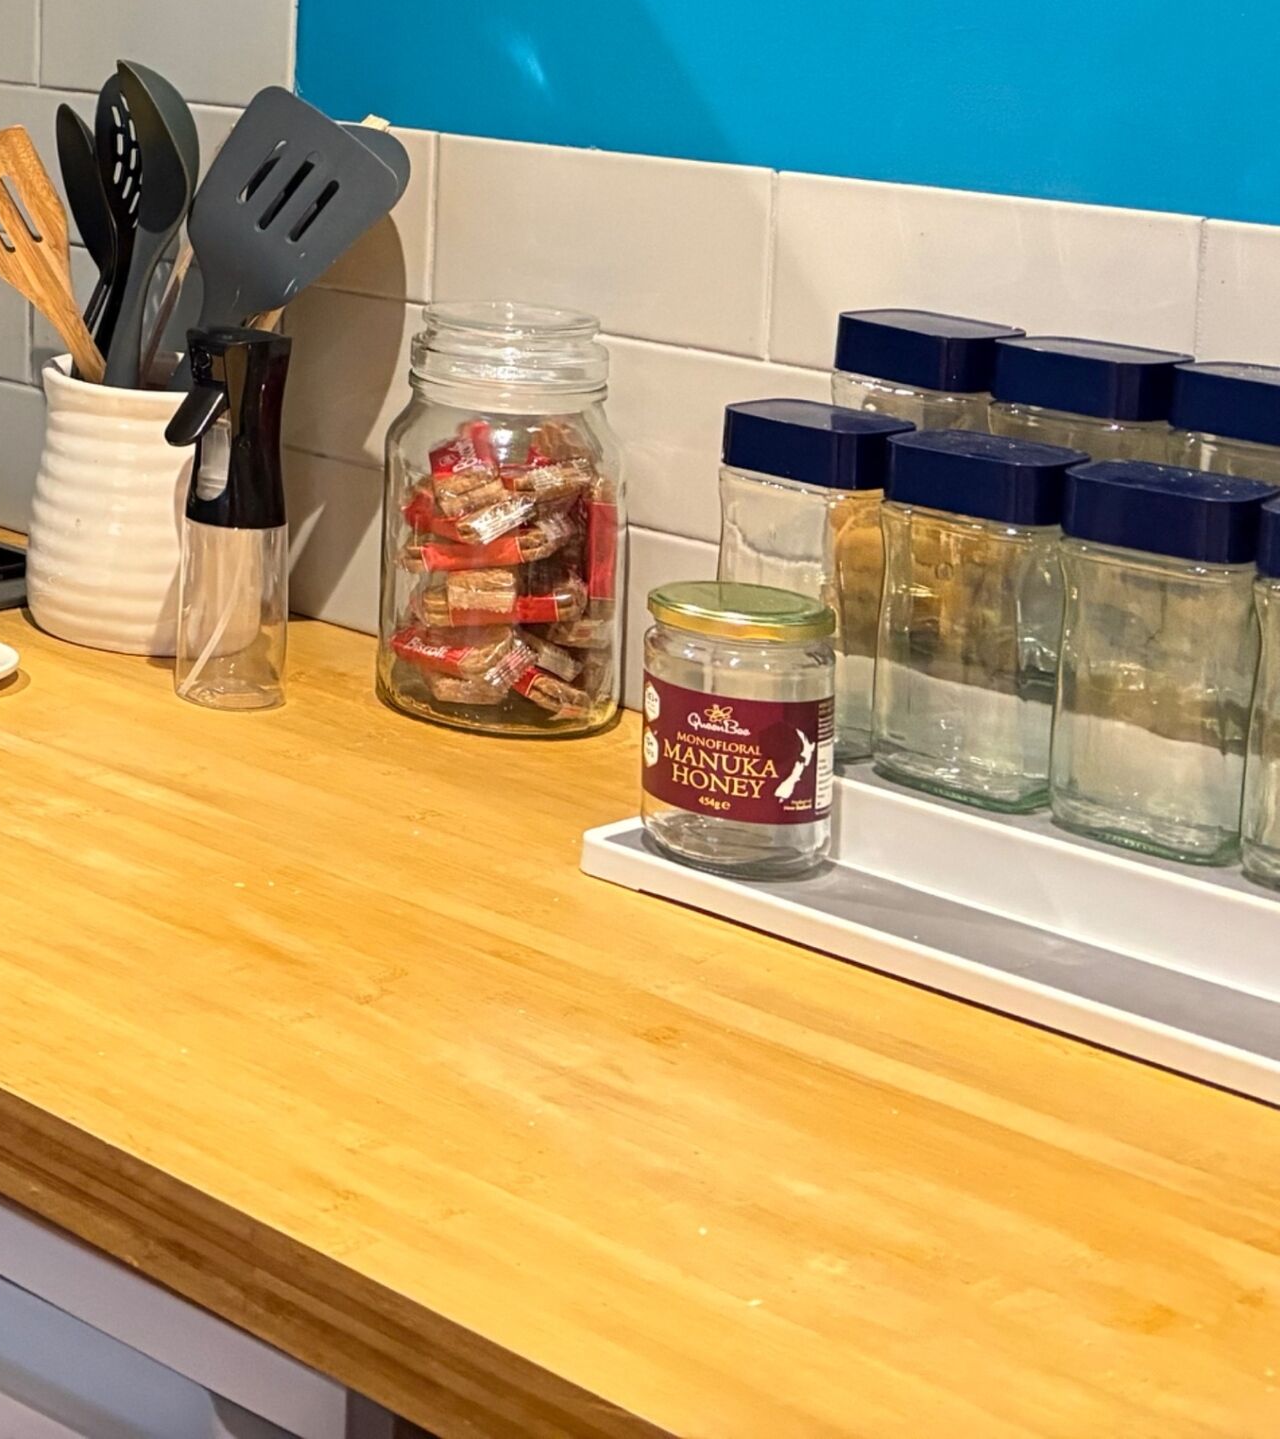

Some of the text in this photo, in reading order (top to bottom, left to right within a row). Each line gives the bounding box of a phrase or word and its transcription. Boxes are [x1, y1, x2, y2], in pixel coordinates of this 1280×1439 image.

[663, 738, 779, 779] MANUKA
[676, 731, 762, 756] MONOFLORAL
[671, 763, 766, 799] HONEY
